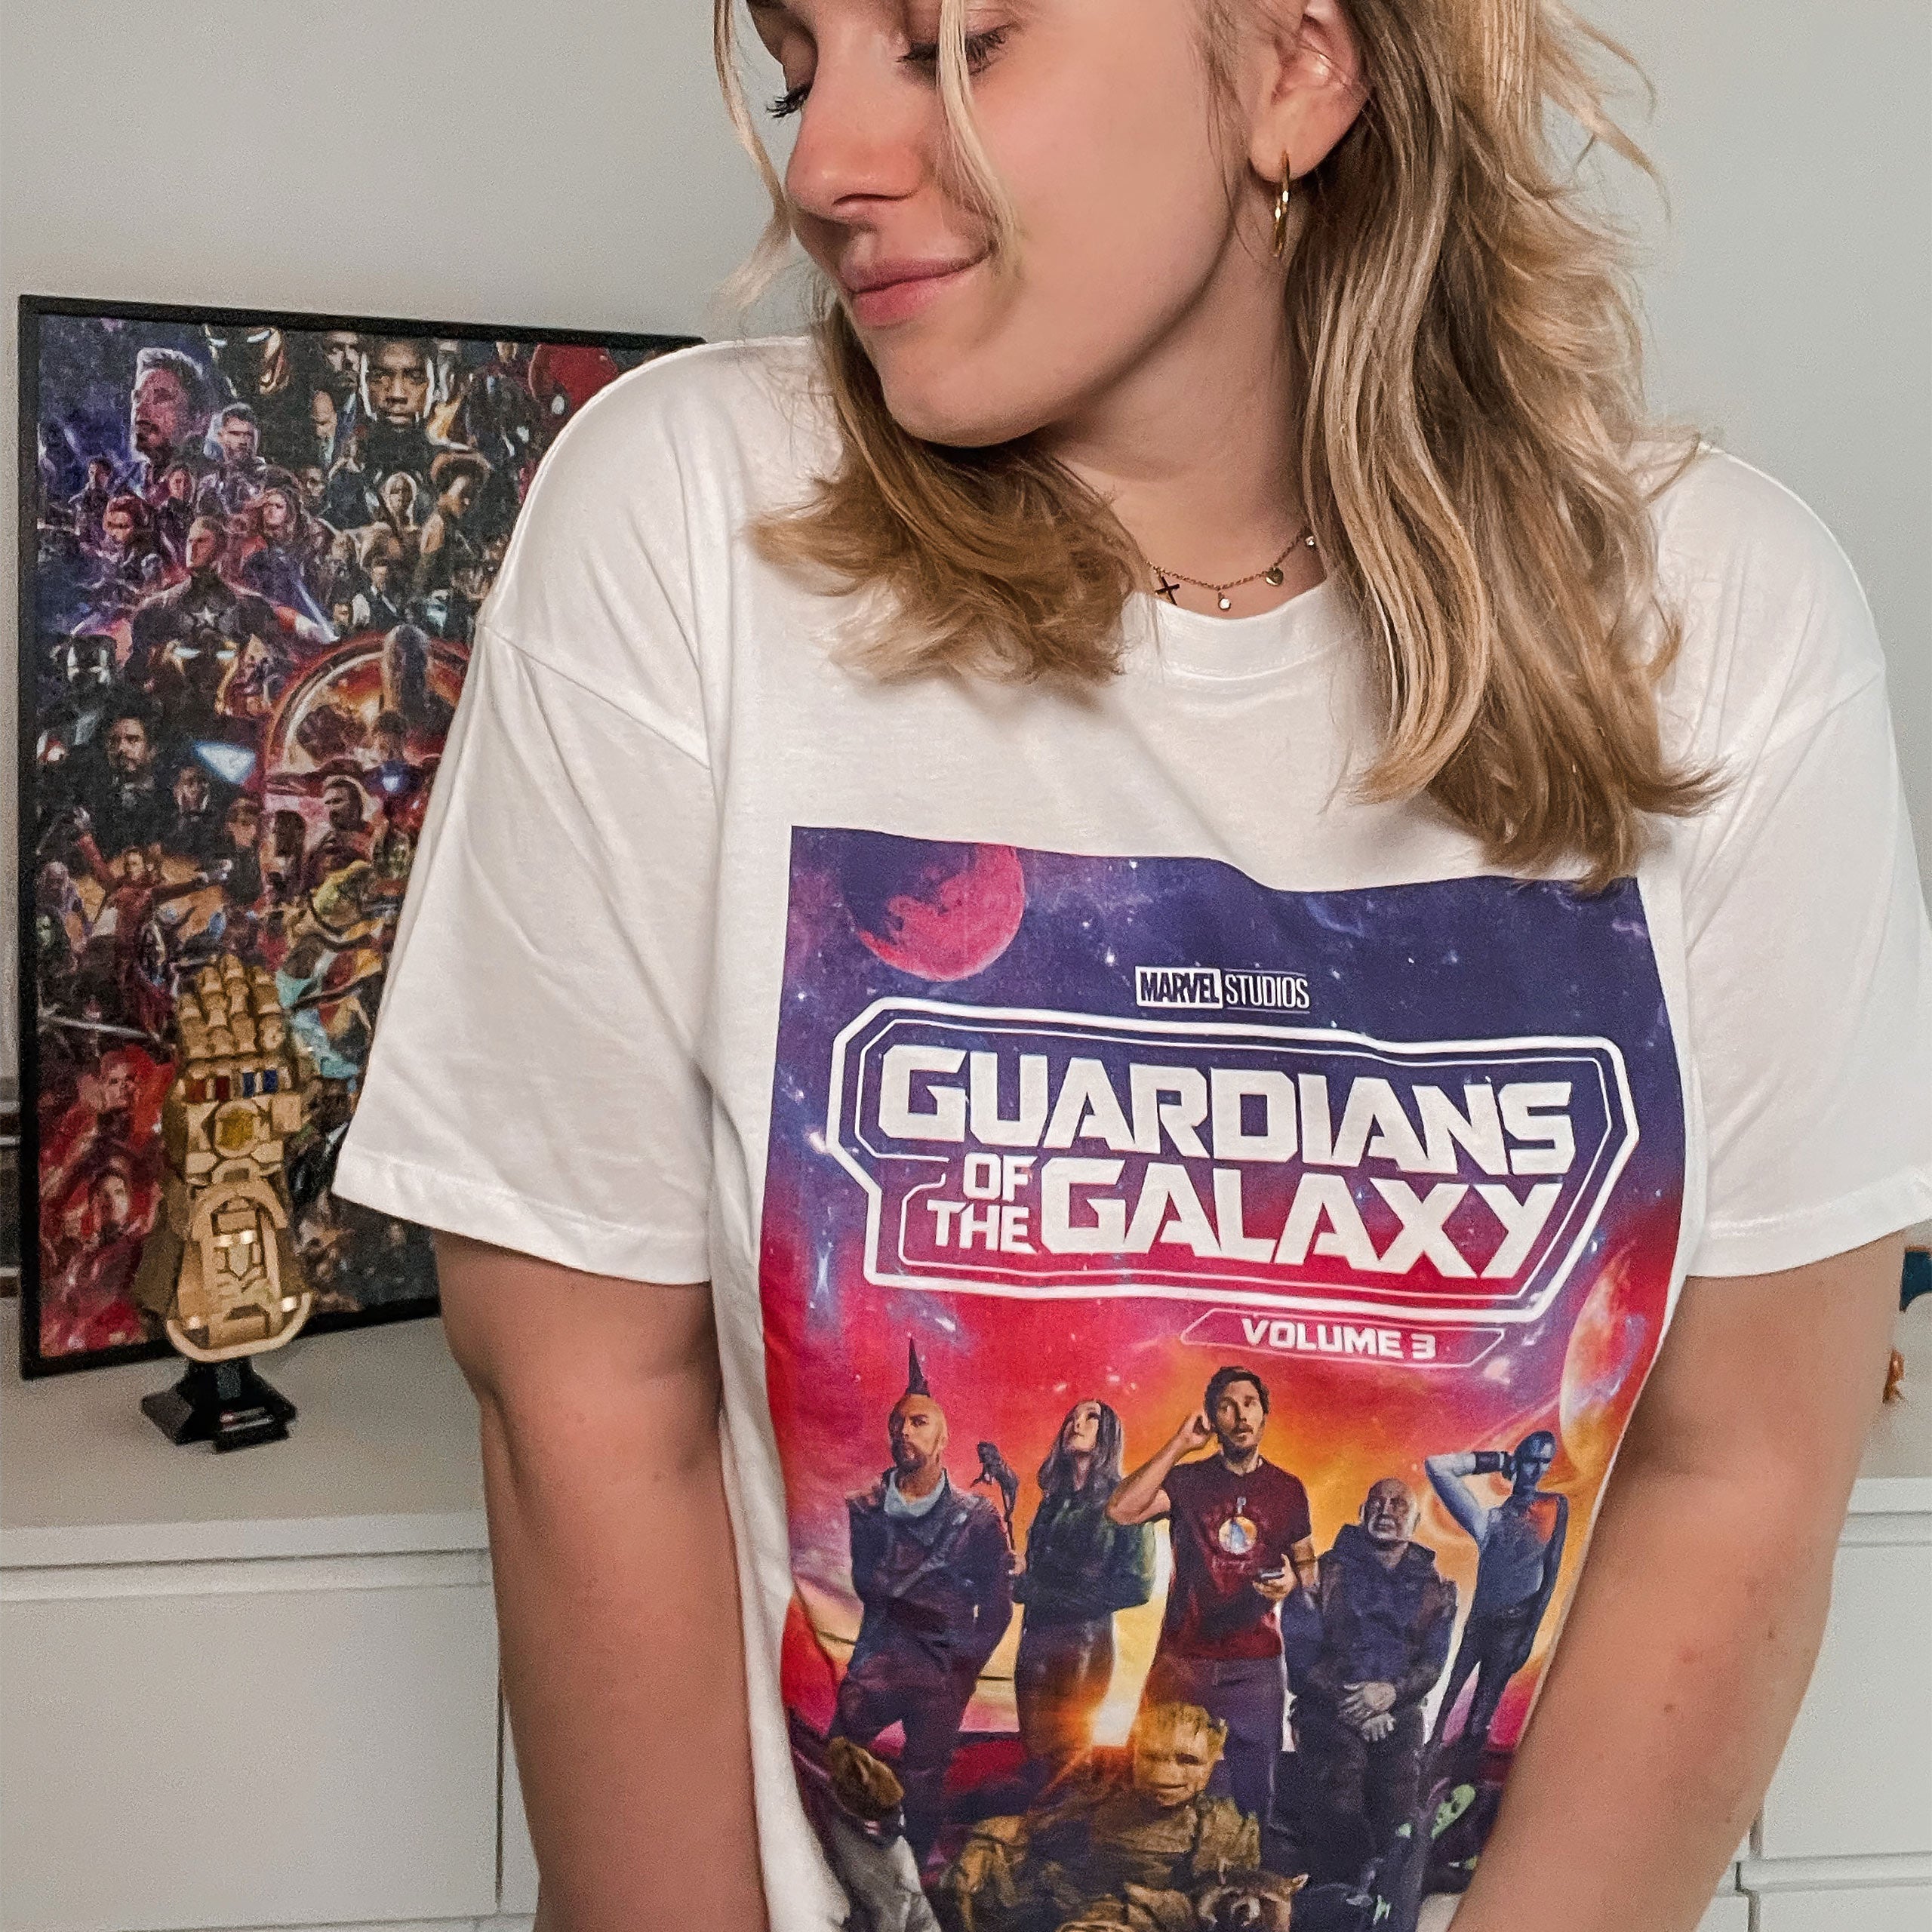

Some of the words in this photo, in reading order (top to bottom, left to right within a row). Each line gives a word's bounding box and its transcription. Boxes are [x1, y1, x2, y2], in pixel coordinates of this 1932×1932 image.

[1139, 971, 1221, 1005] MARVEL
[1224, 974, 1310, 1009] STUDIOS
[878, 1044, 1576, 1176] GUARDIANS
[963, 1152, 1038, 1203] OF
[927, 1198, 1037, 1254] THE
[1041, 1156, 1563, 1278] GALAXY
[1241, 1318, 1404, 1359] VOLUME
[1411, 1334, 1436, 1361] 3
